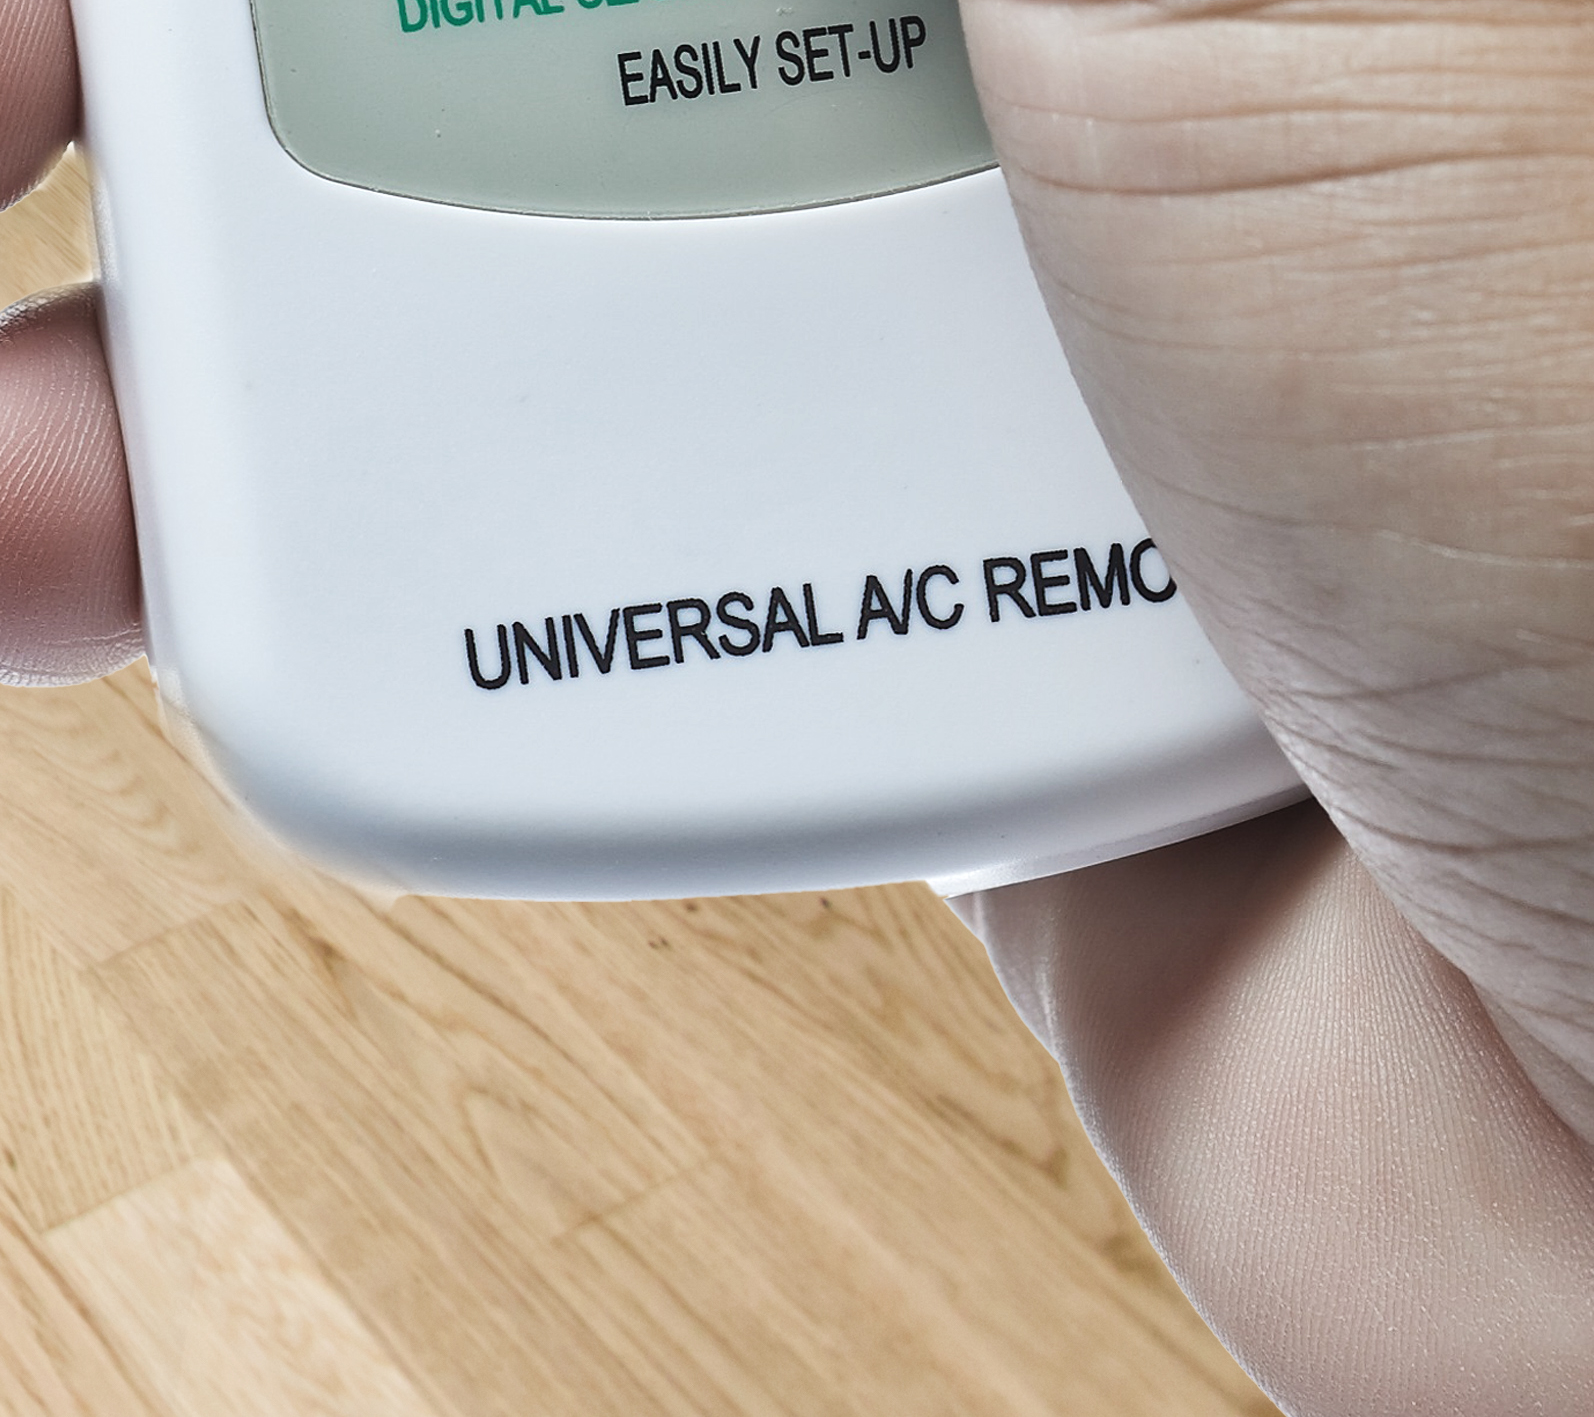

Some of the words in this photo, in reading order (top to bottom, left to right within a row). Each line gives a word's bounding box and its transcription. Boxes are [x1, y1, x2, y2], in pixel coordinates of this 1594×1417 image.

[618, 35, 761, 106] EASILY
[775, 15, 927, 86] SET-UP
[464, 583, 845, 691] UNIVERSAL
[857, 564, 965, 641] A/C
